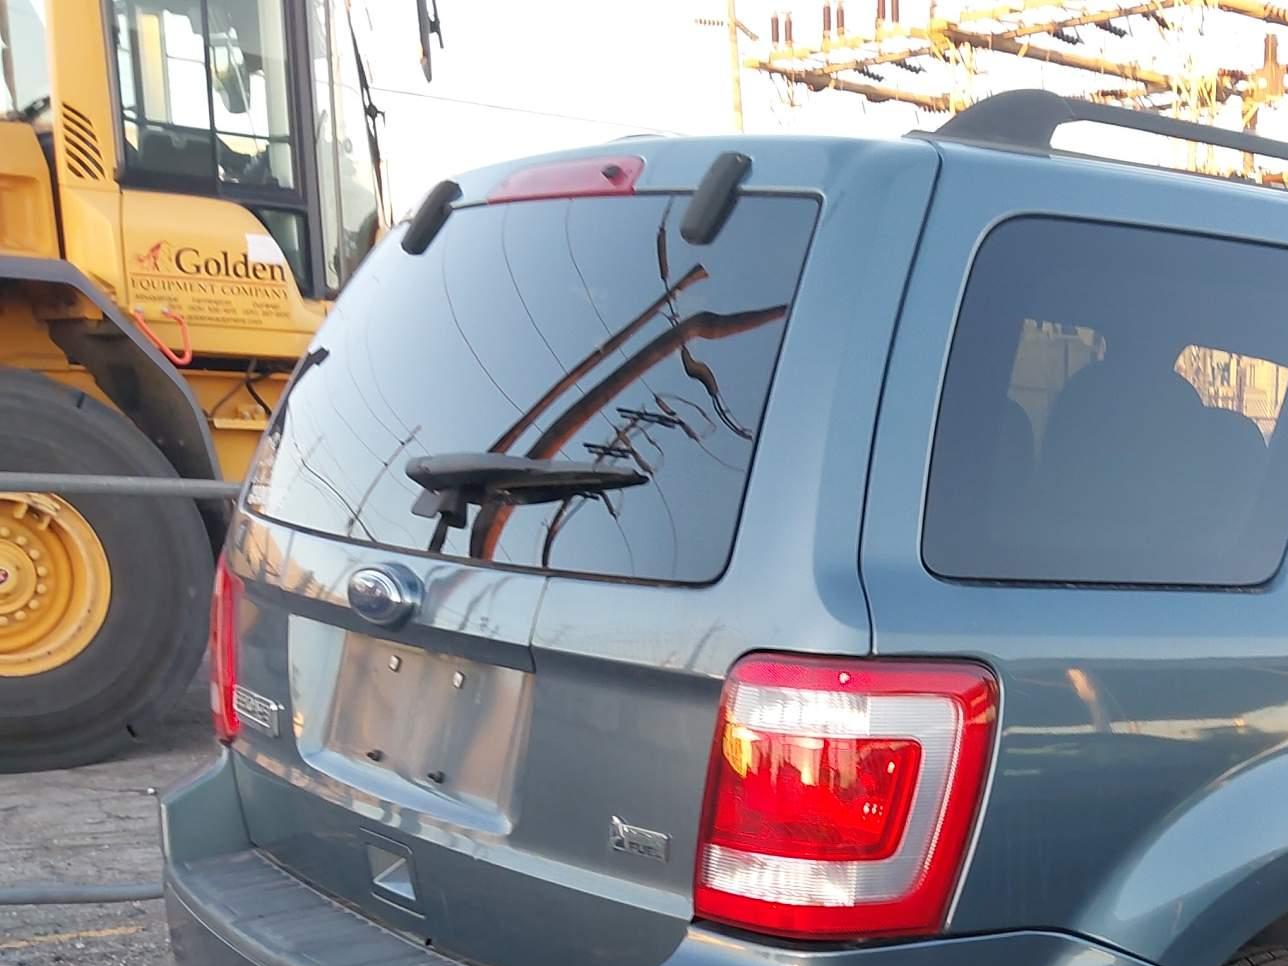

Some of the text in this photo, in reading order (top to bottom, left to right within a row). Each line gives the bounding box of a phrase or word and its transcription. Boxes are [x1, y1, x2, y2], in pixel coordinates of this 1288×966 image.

[175, 247, 287, 282] Golden
[130, 277, 289, 300] EQUIPMENT COMPANY
